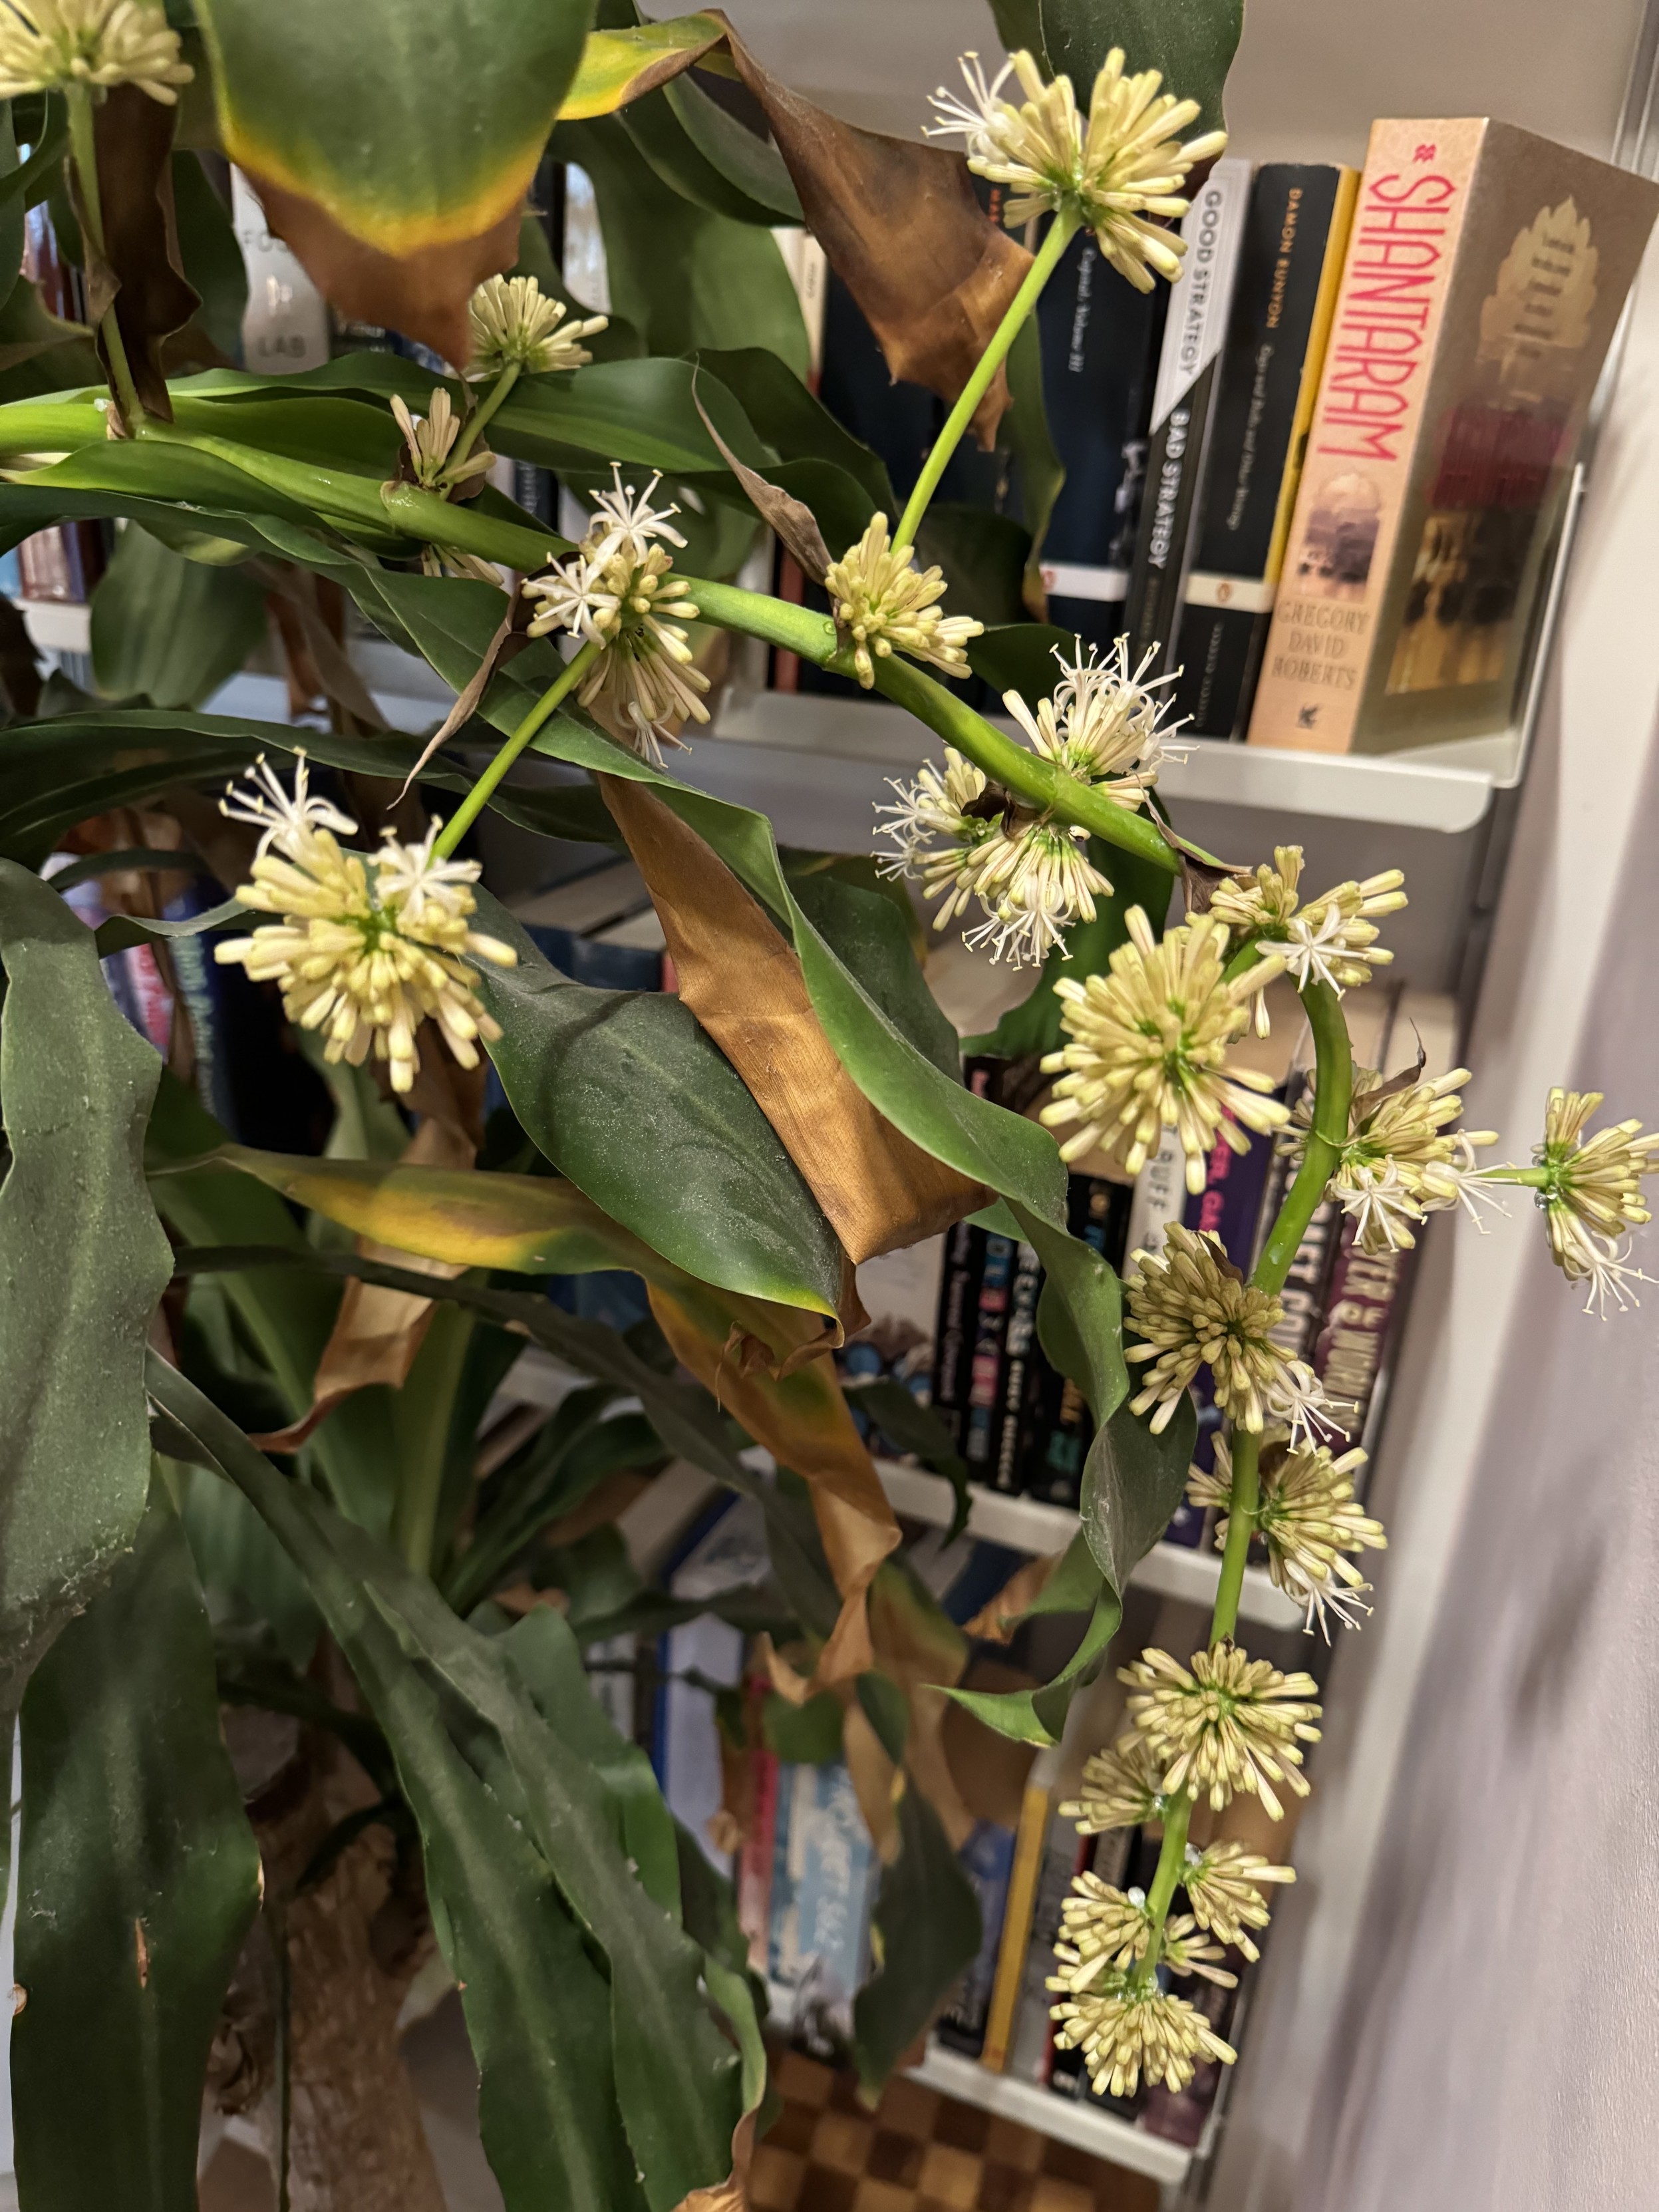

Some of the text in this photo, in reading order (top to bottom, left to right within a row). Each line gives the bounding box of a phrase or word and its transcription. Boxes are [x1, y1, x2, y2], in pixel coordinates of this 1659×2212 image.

[1279, 186, 1304, 253] DAMON
[1179, 190, 1223, 375] GOOD STRATEGY
[1317, 174, 1456, 462] SHANTARAM
[1165, 407, 1191, 459] BAD
[1147, 459, 1183, 570] STRATEGY
[1277, 601, 1370, 635] GREGORY
[1288, 630, 1349, 660] DAVID
[1271, 655, 1358, 691] ROBERTS
